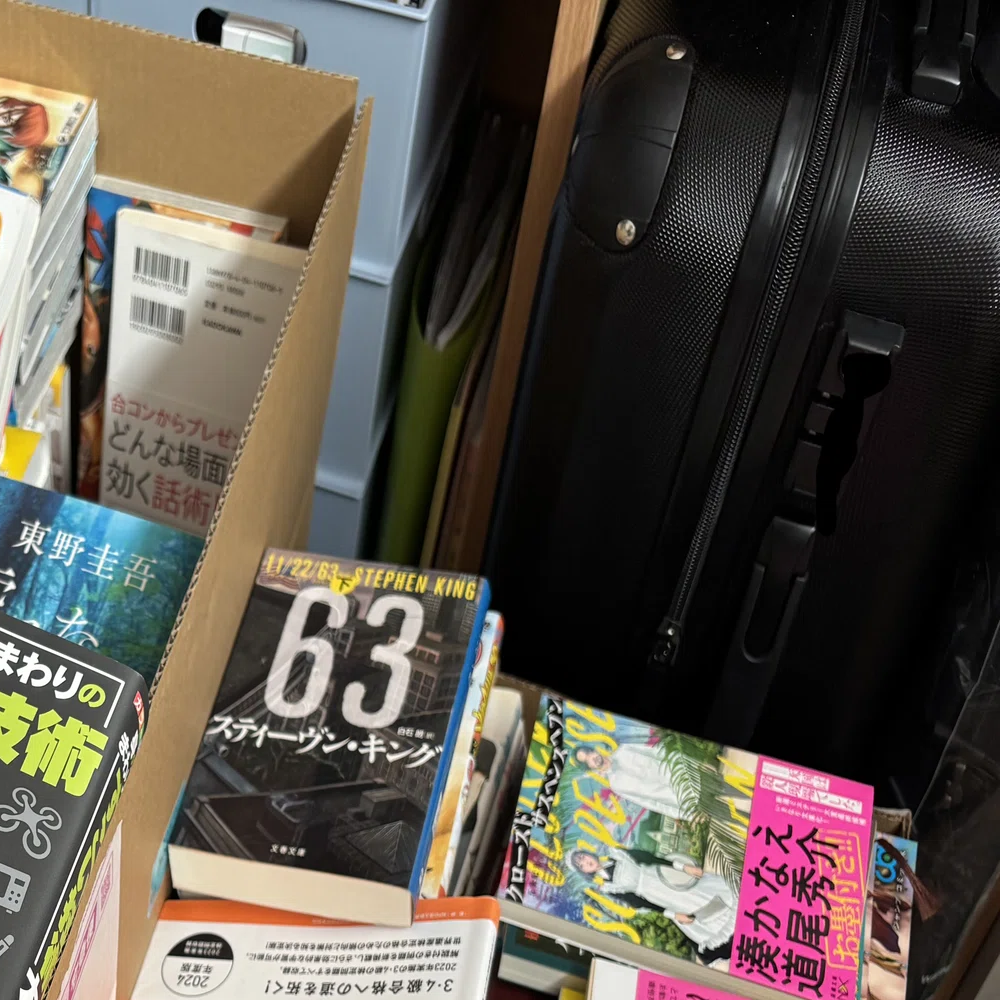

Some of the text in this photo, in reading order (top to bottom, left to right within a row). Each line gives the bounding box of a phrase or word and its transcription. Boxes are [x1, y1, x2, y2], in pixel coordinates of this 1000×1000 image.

[111, 393, 238, 448] 合コンからプレゼ
[106, 459, 221, 528] 効く話術
[13, 519, 158, 592] 東野圭吾
[266, 555, 478, 600] 11/22/63 STEPHEN KING
[333, 575, 353, 591] 下
[261, 583, 428, 731] 63
[205, 716, 443, 768] スティーヴン・キング
[733, 824, 792, 982] 湊かなえ
[778, 829, 839, 998] 道尾秀介
[174, 973, 210, 987] 2024
[179, 962, 214, 974] 年度版
